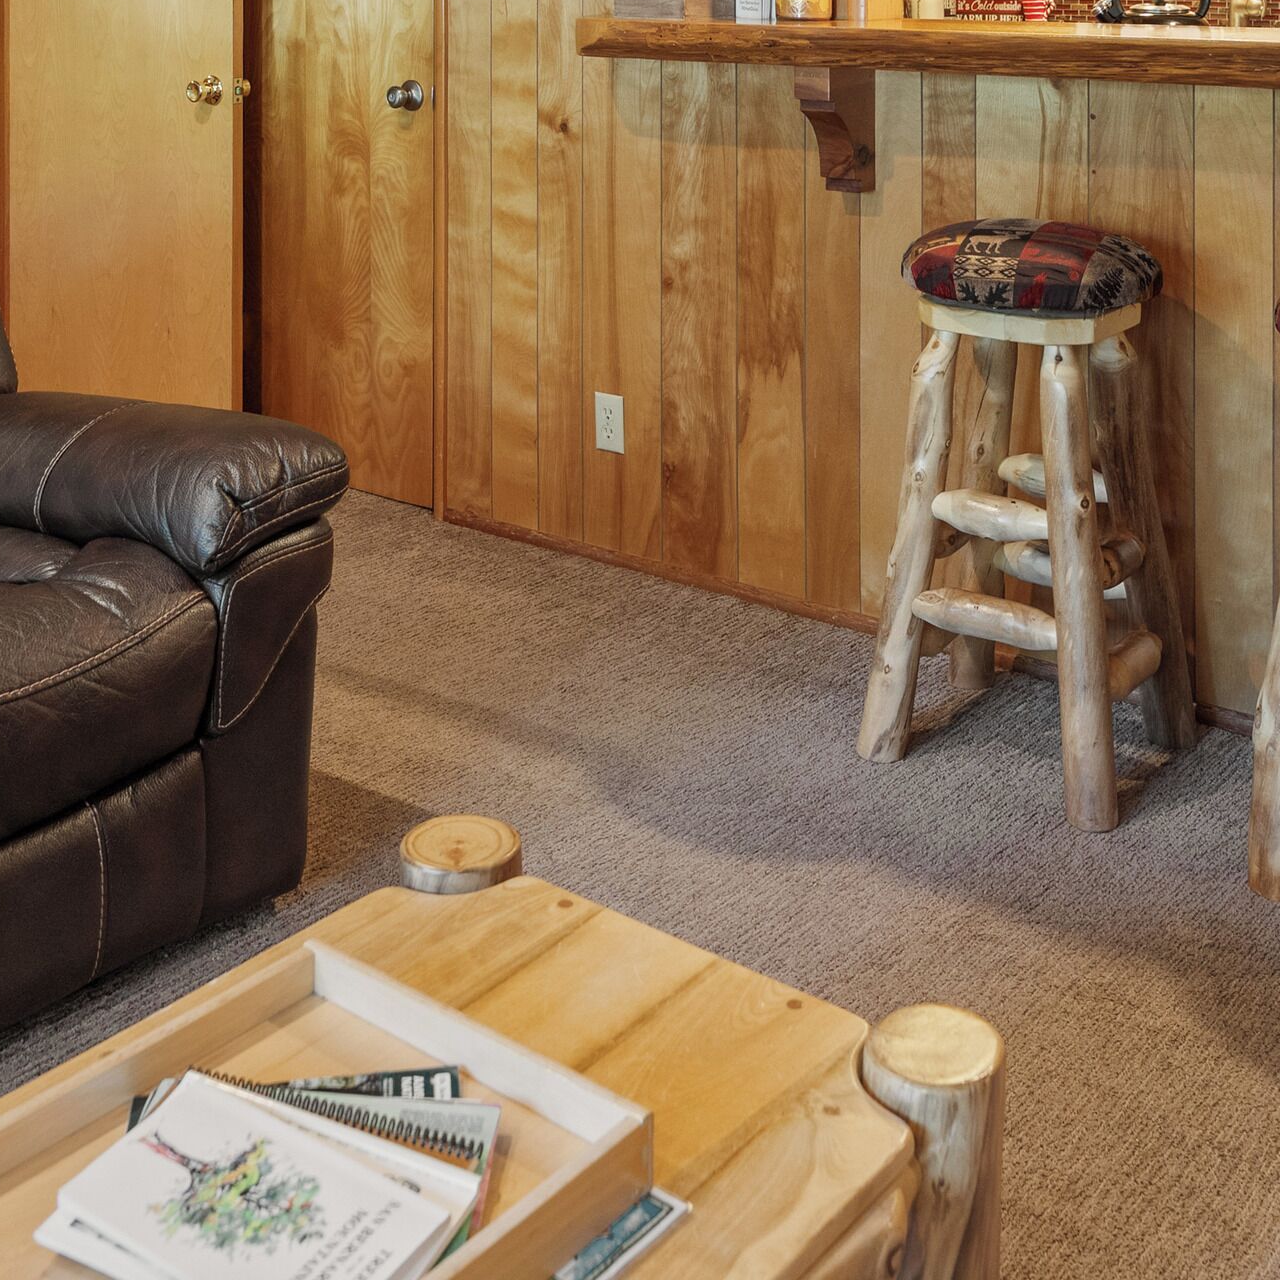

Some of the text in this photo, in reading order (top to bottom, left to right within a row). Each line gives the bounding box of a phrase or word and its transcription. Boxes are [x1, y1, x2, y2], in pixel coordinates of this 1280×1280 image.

[957, 0, 1022, 11] it's Cold outside
